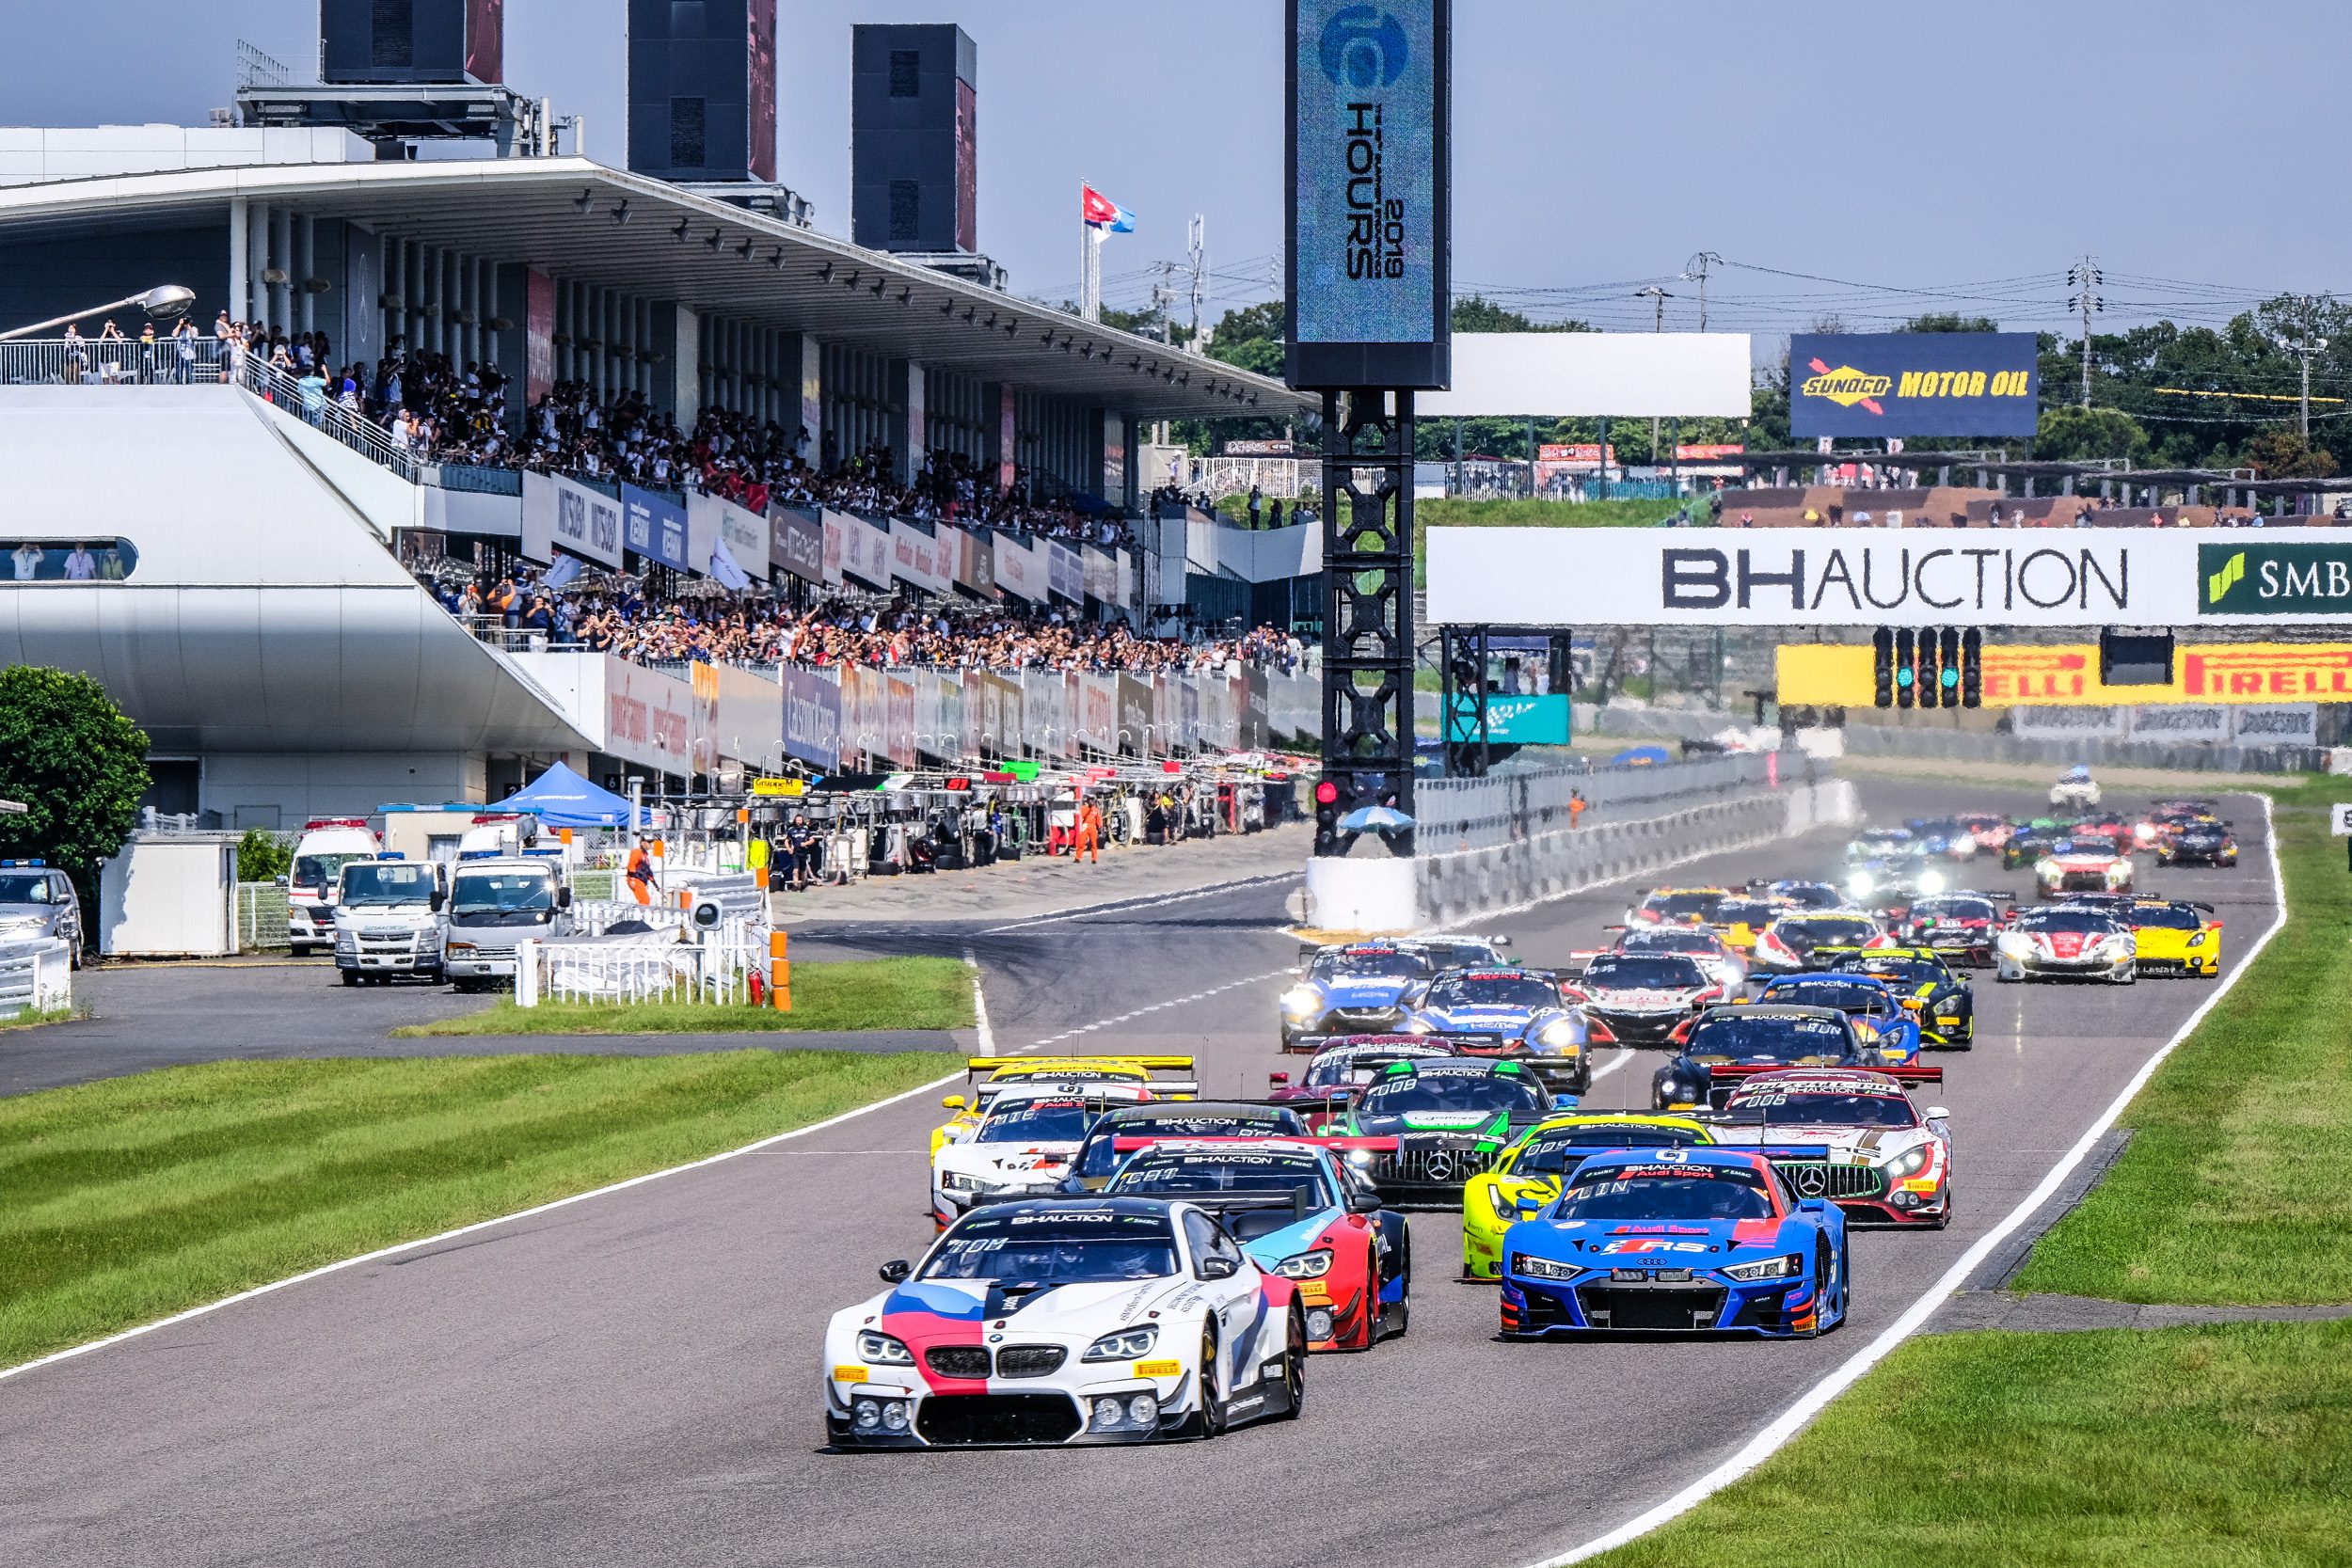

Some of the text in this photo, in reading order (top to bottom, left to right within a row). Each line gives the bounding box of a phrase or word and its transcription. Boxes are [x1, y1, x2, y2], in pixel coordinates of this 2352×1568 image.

[1347, 103, 1373, 279] HOURS
[1385, 199, 1404, 279] 2019
[1805, 371, 2028, 398] SUNOCO MOTOR OIL
[1674, 1169, 1714, 1179] Sport
[1137, 1362, 1177, 1375] PIRELLI
